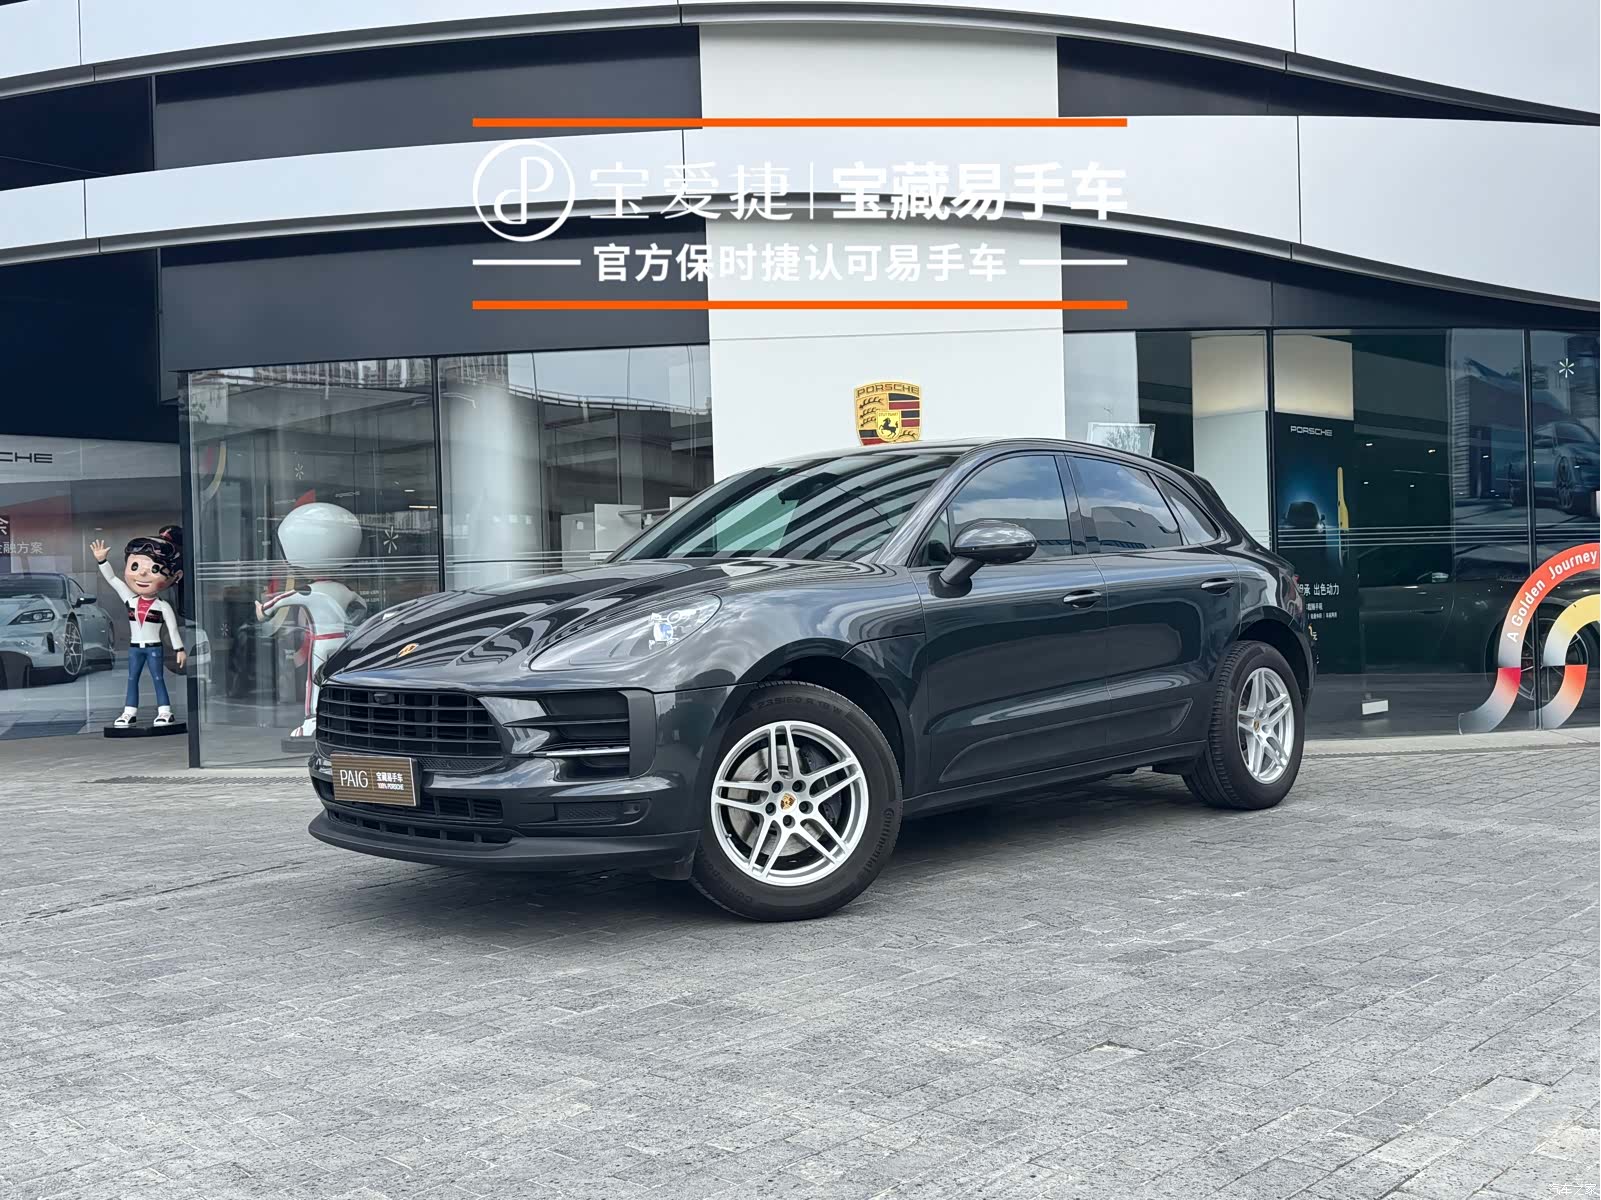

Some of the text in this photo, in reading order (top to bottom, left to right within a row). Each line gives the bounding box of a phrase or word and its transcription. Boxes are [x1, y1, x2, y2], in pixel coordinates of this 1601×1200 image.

[857, 383, 920, 397] PORSCHE
[1290, 425, 1333, 437] PORSCHE
[0, 541, 44, 554] 融方案
[1506, 550, 1598, 644] A Golden Journey
[339, 769, 369, 789] PAIG
